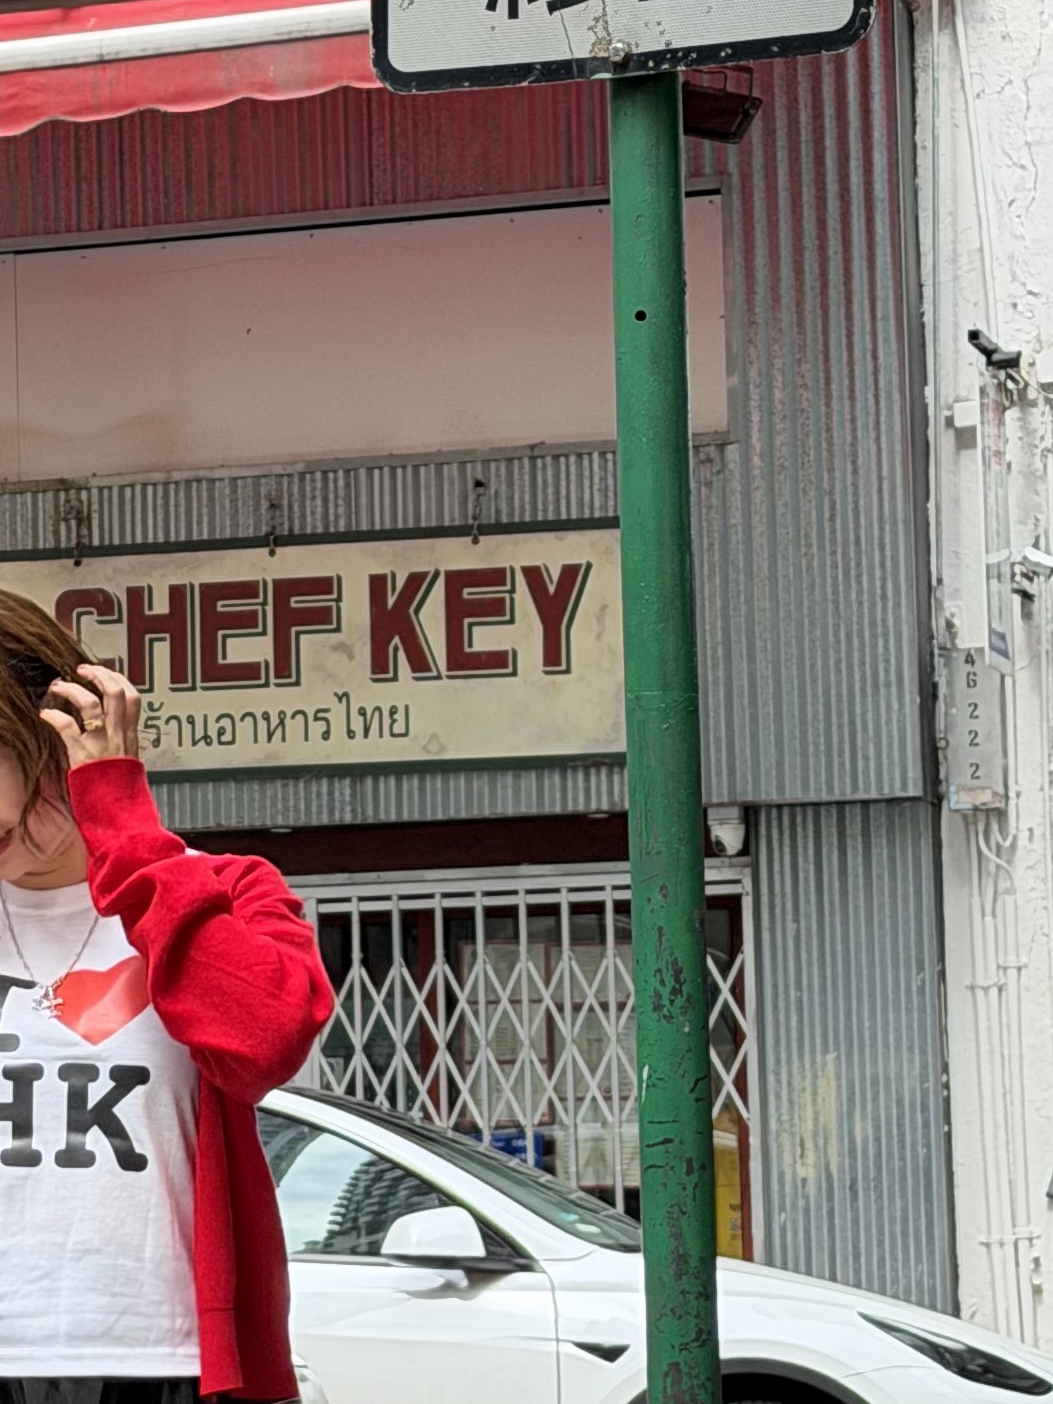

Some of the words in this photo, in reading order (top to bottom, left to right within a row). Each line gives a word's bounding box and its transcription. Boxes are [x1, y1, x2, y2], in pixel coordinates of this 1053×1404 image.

[368, 561, 593, 683] KEY
[143, 691, 410, 749] ร้านอาหารไทย
